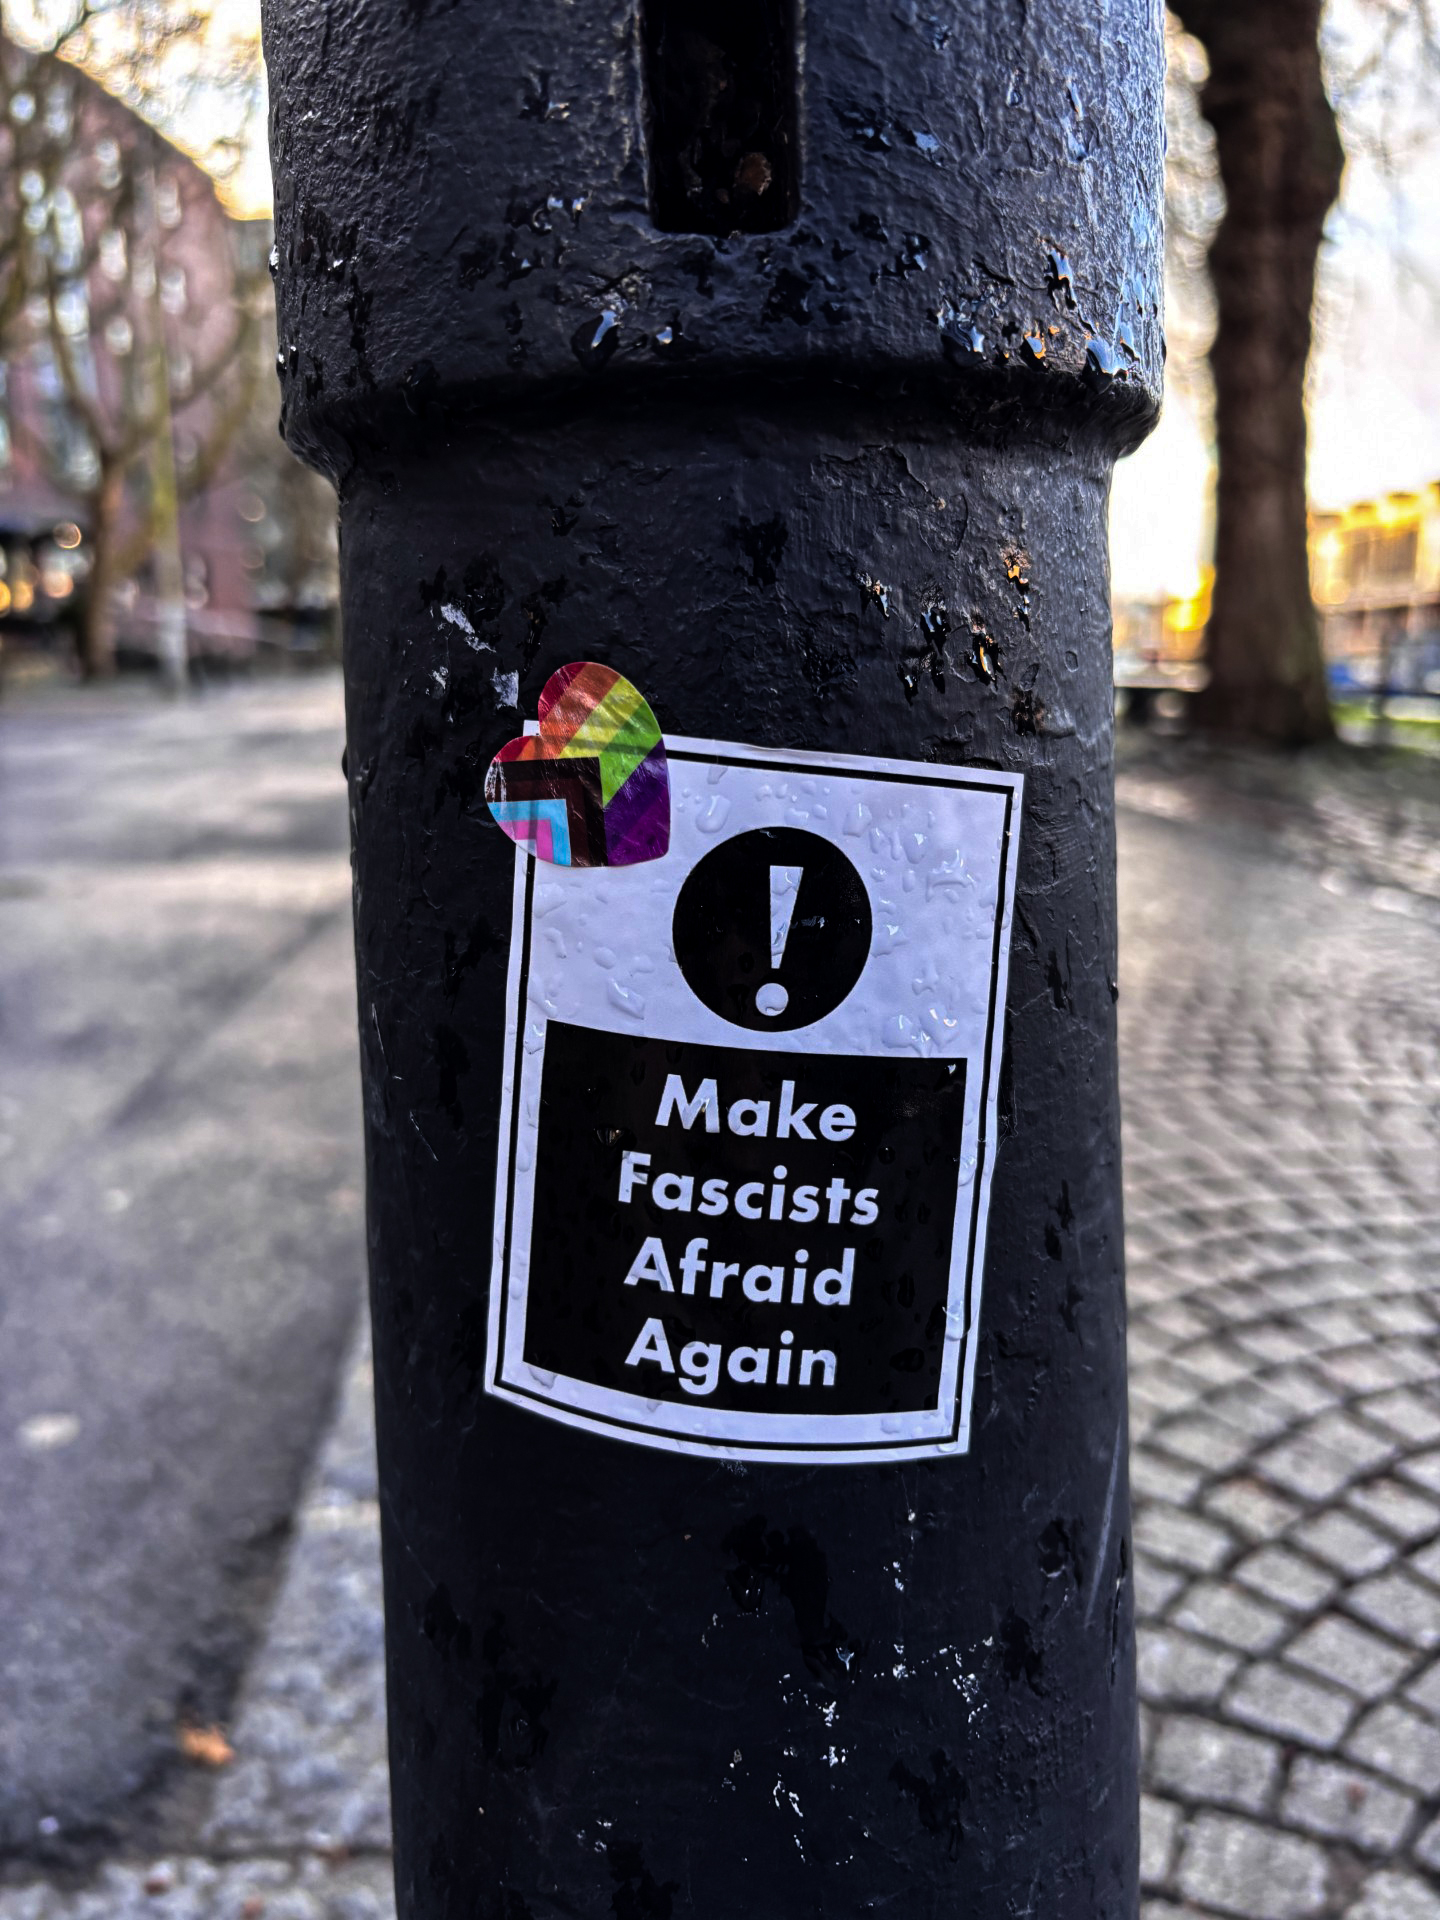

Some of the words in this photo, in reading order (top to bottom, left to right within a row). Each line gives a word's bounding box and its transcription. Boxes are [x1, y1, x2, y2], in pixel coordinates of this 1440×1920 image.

[654, 1073, 857, 1142] Make
[618, 1150, 879, 1225] Fascists
[623, 1236, 856, 1306] Afraid
[624, 1317, 838, 1395] Again
